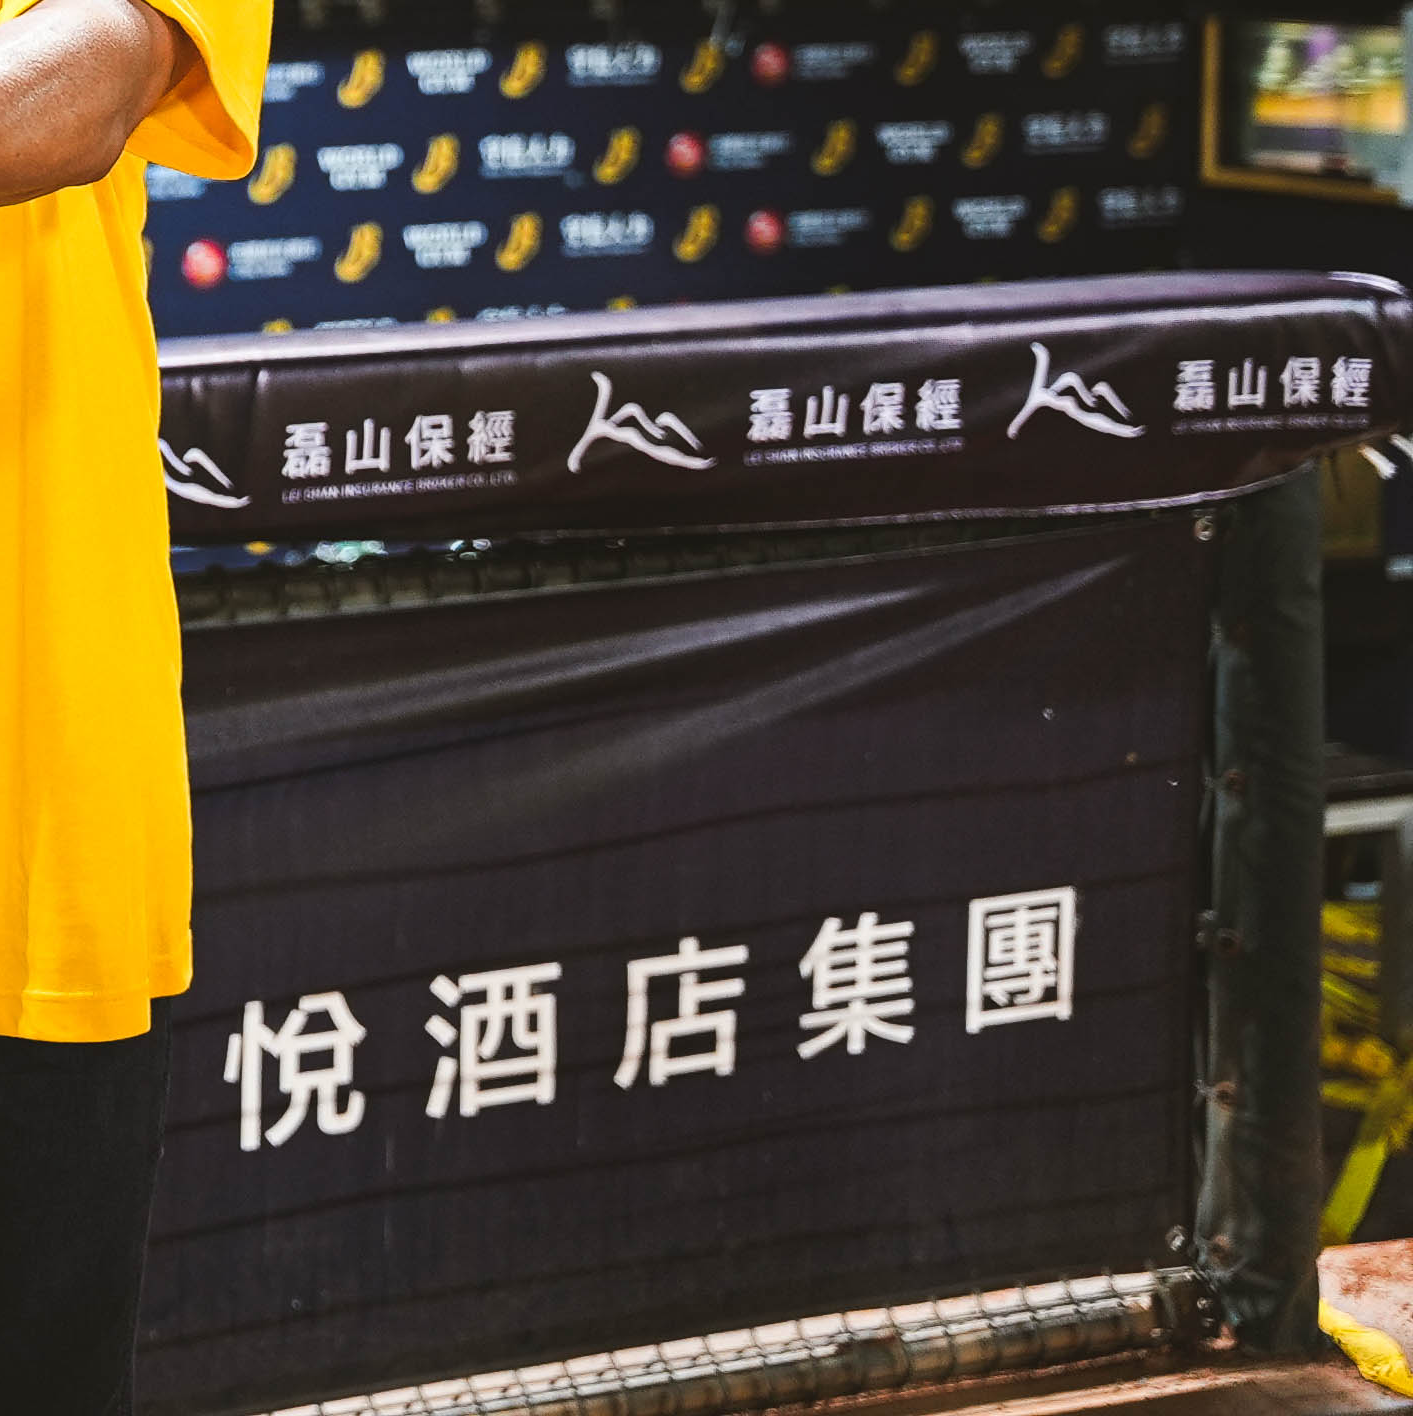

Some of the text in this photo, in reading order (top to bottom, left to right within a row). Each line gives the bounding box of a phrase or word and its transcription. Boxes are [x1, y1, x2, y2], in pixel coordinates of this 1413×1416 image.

[746, 378, 962, 442] 磊山保經
[1172, 356, 1372, 411] 磊山保經
[281, 410, 517, 480] 磊山保經
[223, 885, 1078, 1152] 悅酒店集團
